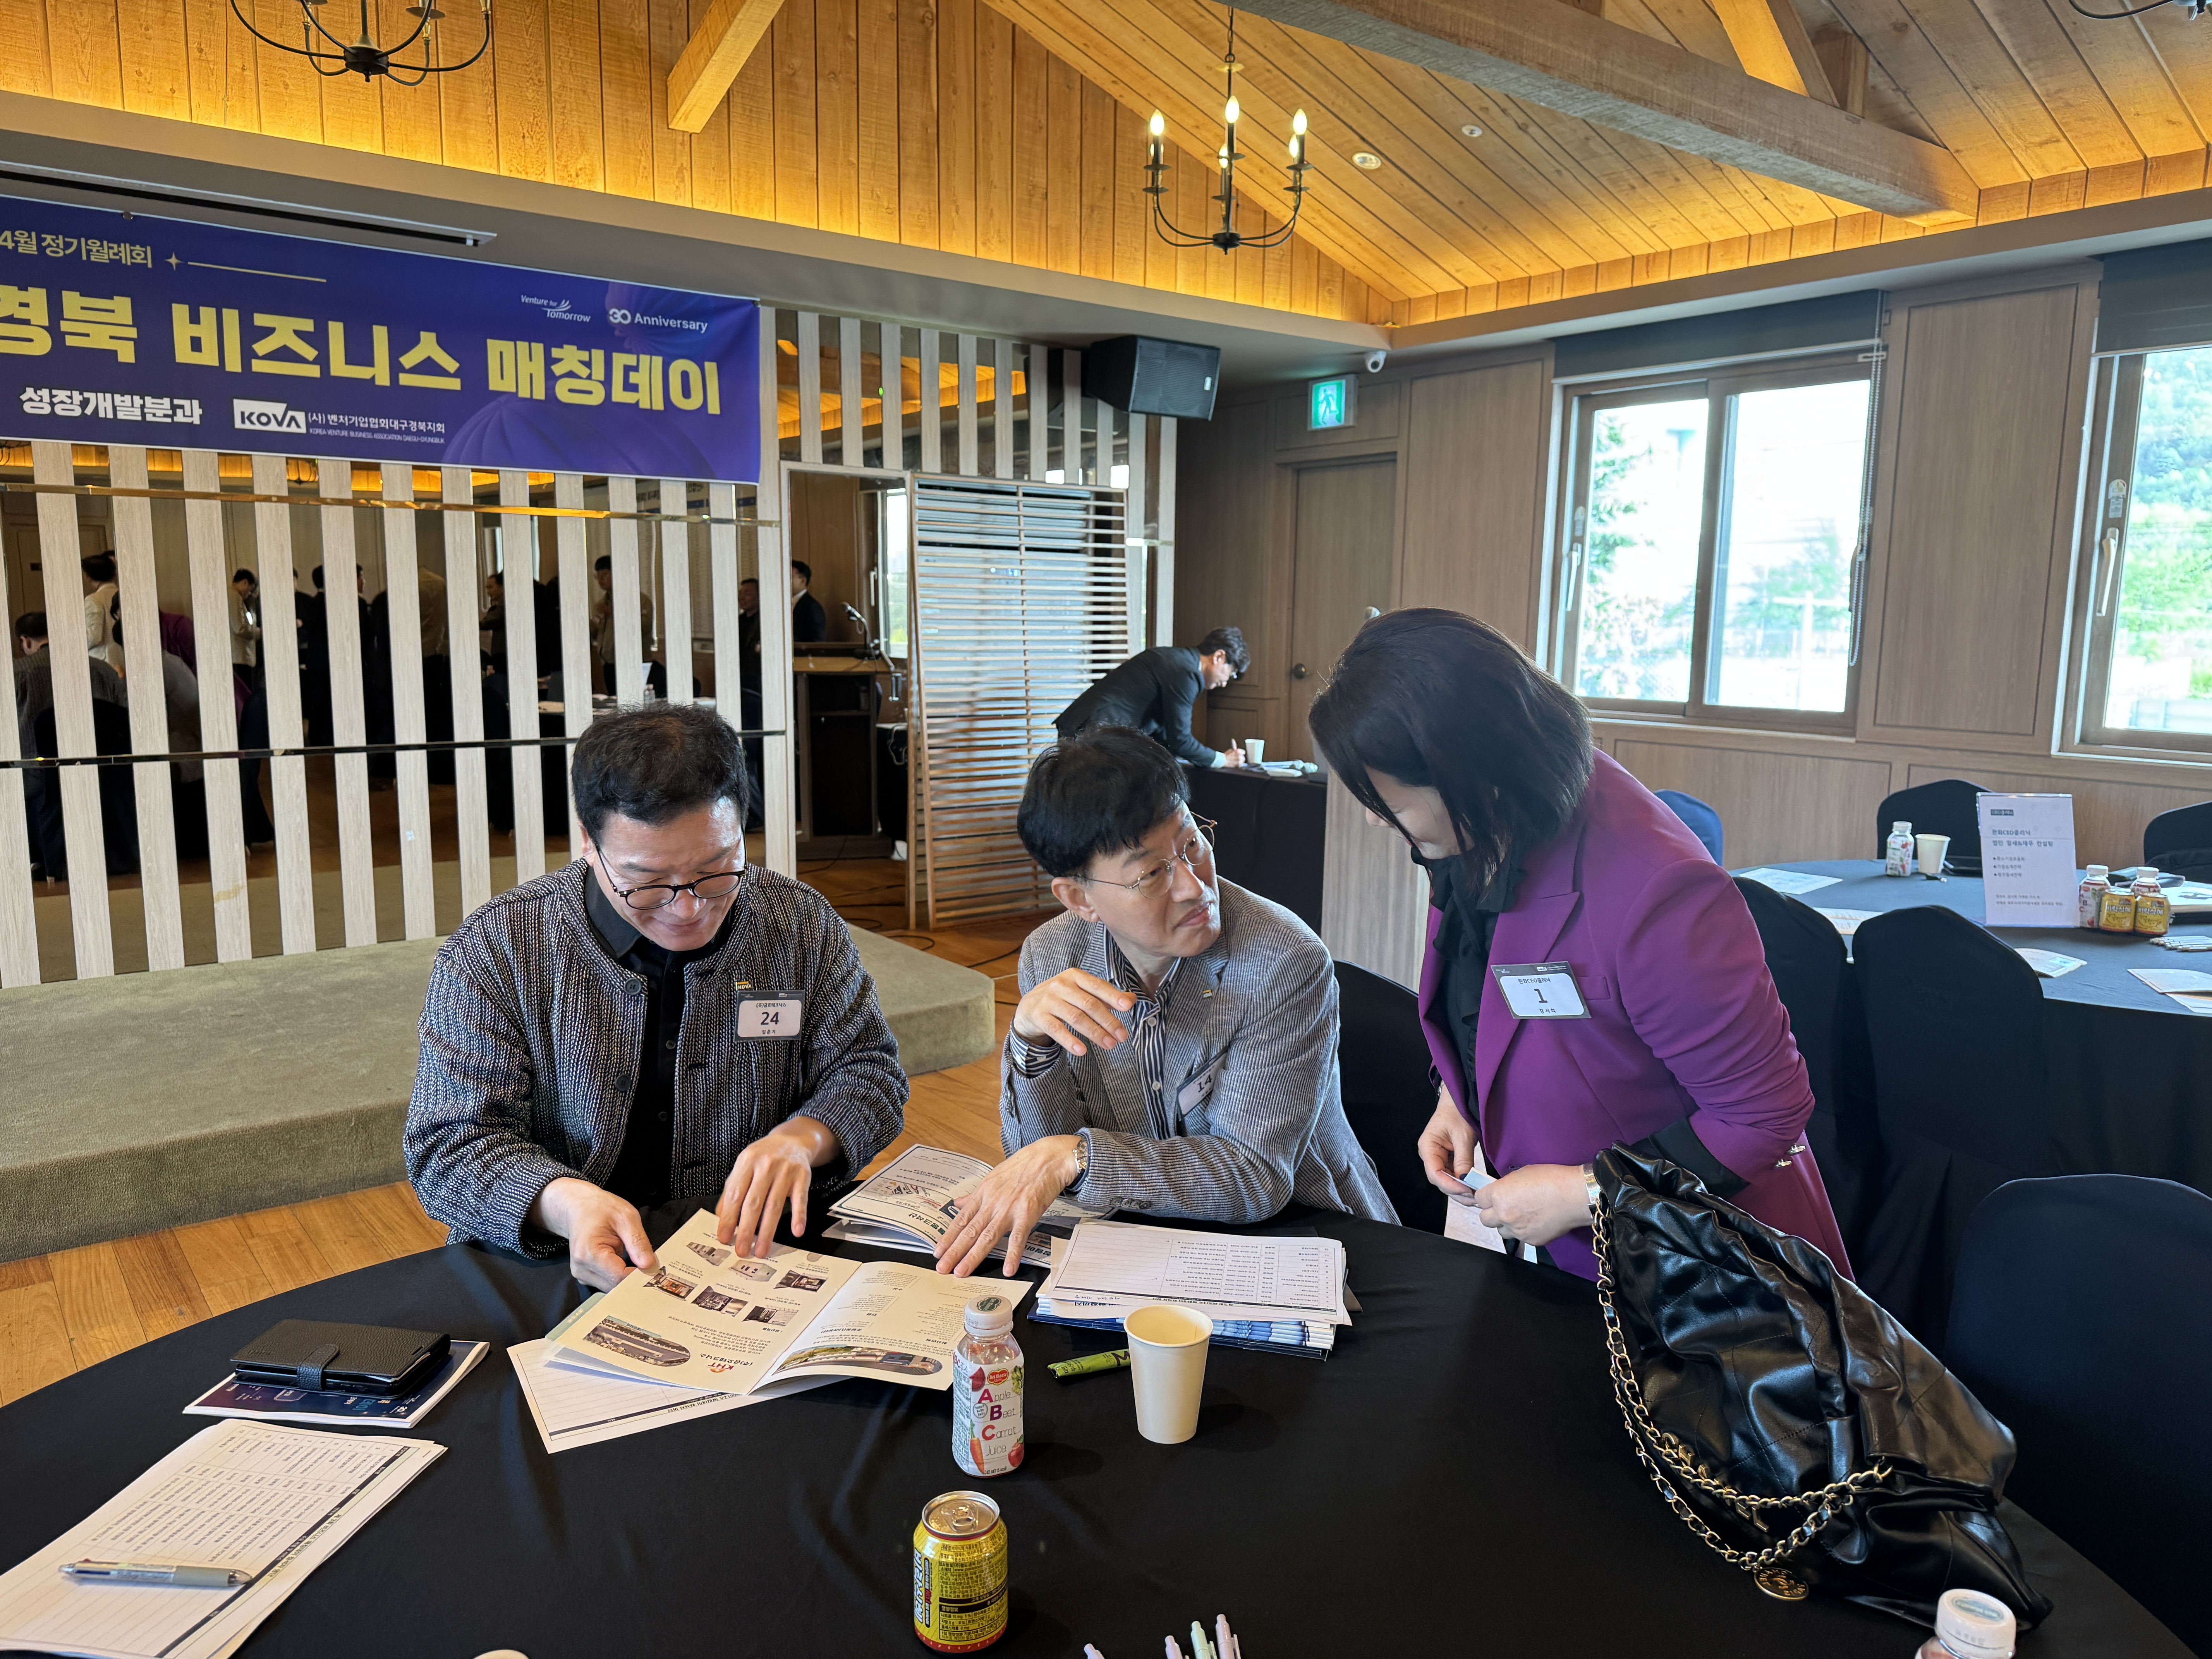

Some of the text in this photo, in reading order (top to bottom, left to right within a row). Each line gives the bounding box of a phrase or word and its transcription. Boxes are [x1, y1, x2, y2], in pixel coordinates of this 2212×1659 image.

[0, 230, 152, 268] 4월 정기월례회
[521, 295, 548, 306] Venture
[547, 309, 591, 323] Tomorrow
[609, 308, 708, 334] 30 Anniversary
[0, 285, 721, 415] 경북 비즈니스 매칭데이
[20, 387, 203, 424] 성장개발분과
[240, 405, 302, 428] KOVA
[309, 412, 325, 424] (사)
[1534, 988, 1548, 1003] 1
[761, 1012, 780, 1025] 24
[1197, 1074, 1212, 1093] 14
[706, 1362, 734, 1370] KHT
[978, 1388, 1011, 1403] Apple
[990, 1404, 1015, 1421] Beet
[982, 1424, 1017, 1441] Carrot
[986, 1444, 1007, 1456] Juice
[914, 1547, 924, 1624] 비락식혜
